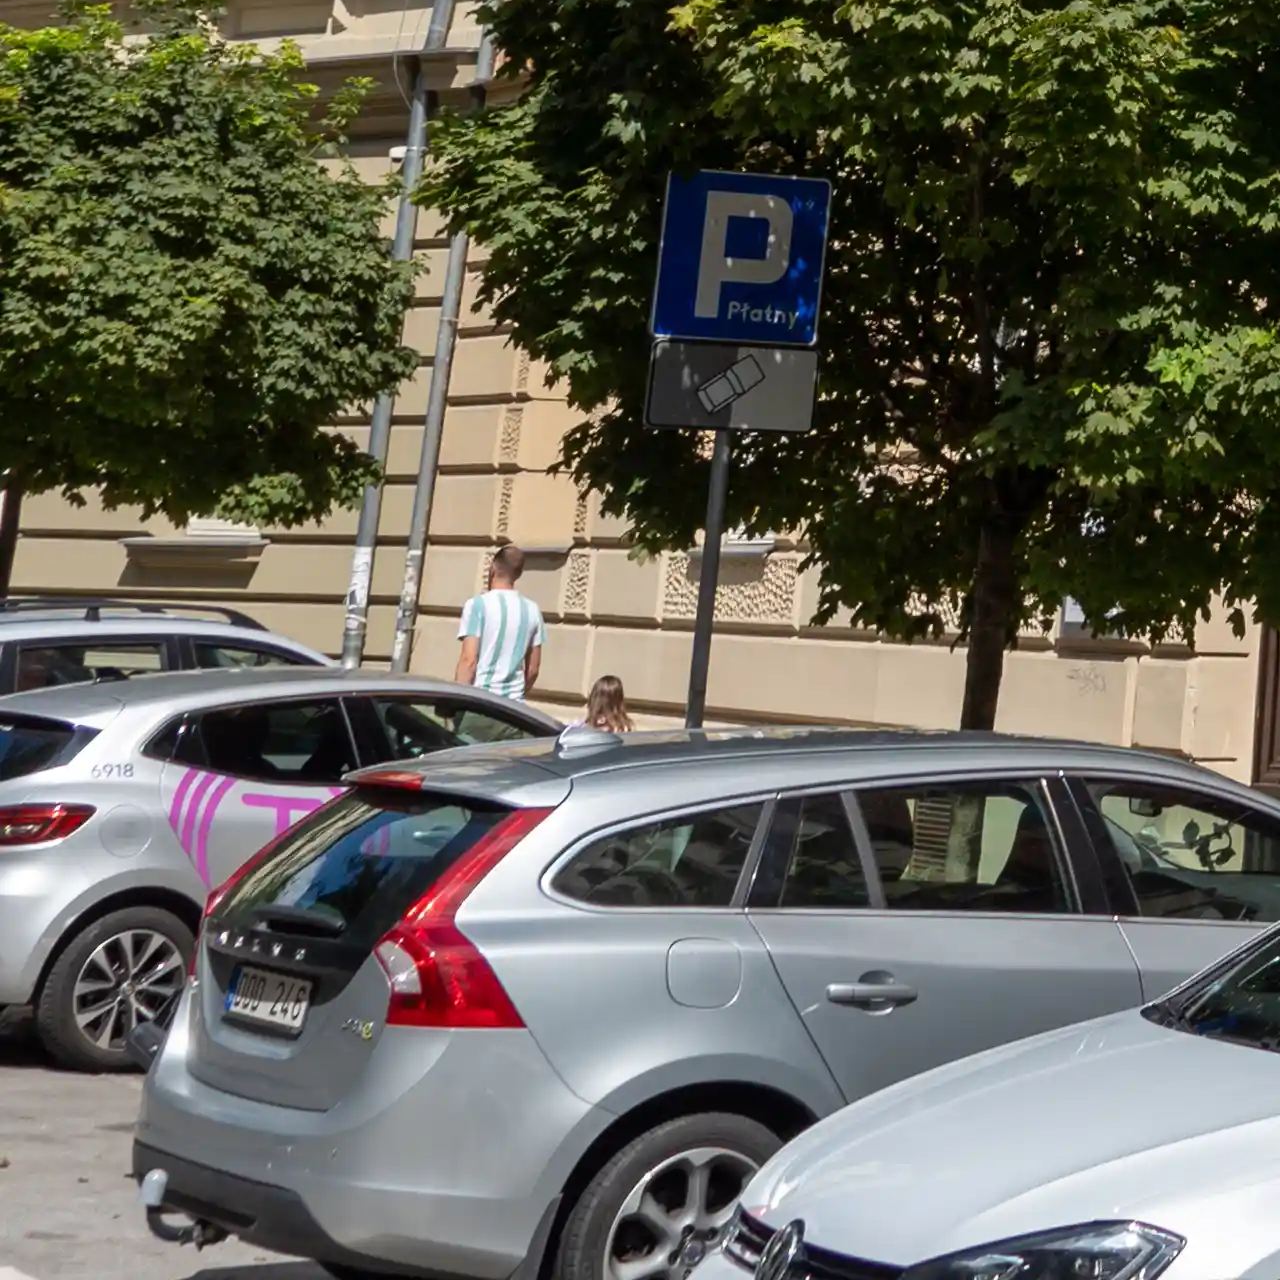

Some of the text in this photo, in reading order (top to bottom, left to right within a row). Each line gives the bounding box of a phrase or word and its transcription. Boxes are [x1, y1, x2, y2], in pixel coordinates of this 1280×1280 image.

[694, 190, 793, 318] P
[727, 300, 800, 330] Płatny
[91, 762, 134, 779] 6918
